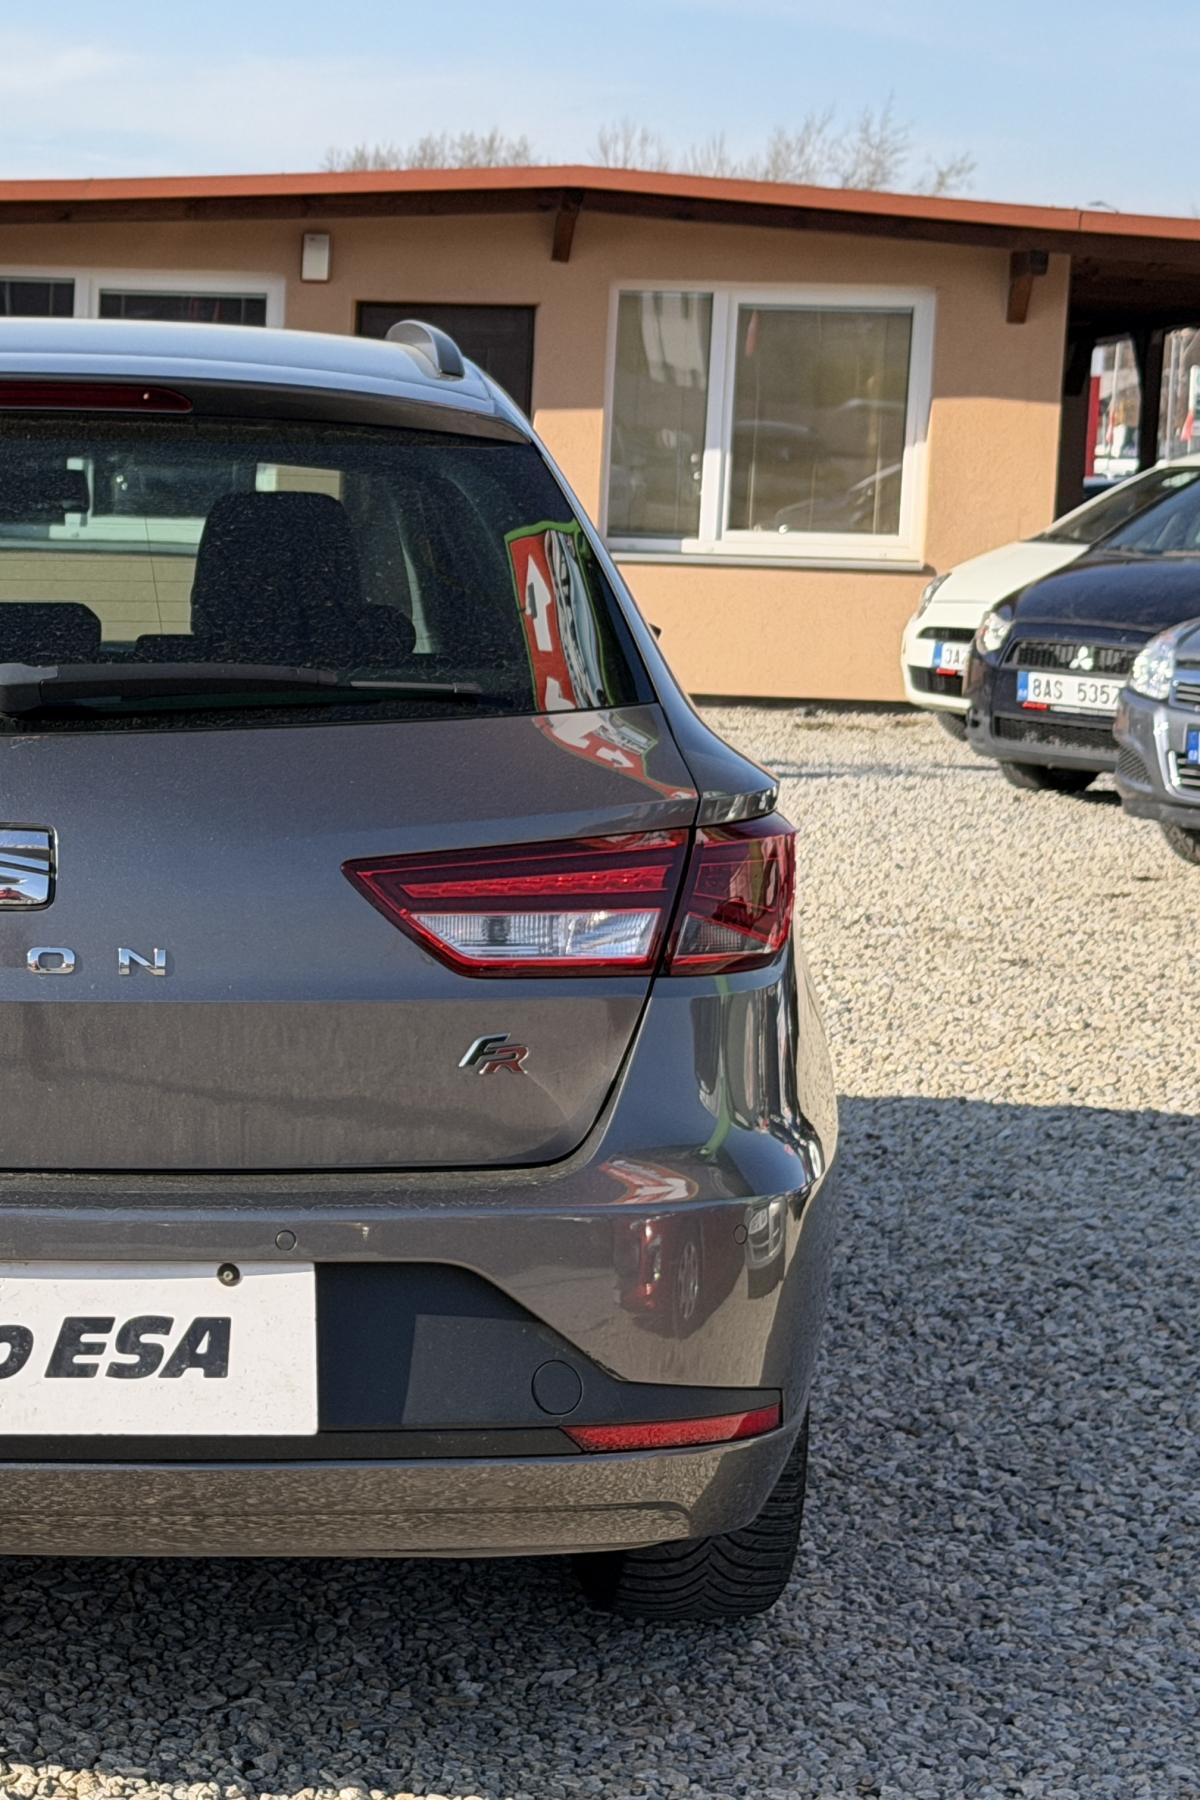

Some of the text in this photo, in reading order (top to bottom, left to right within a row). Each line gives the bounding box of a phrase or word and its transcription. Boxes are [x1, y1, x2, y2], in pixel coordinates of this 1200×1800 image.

[1032, 678, 1063, 700] 8AS
[458, 1032, 529, 1074] FR
[44, 1315, 231, 1378] ESA
